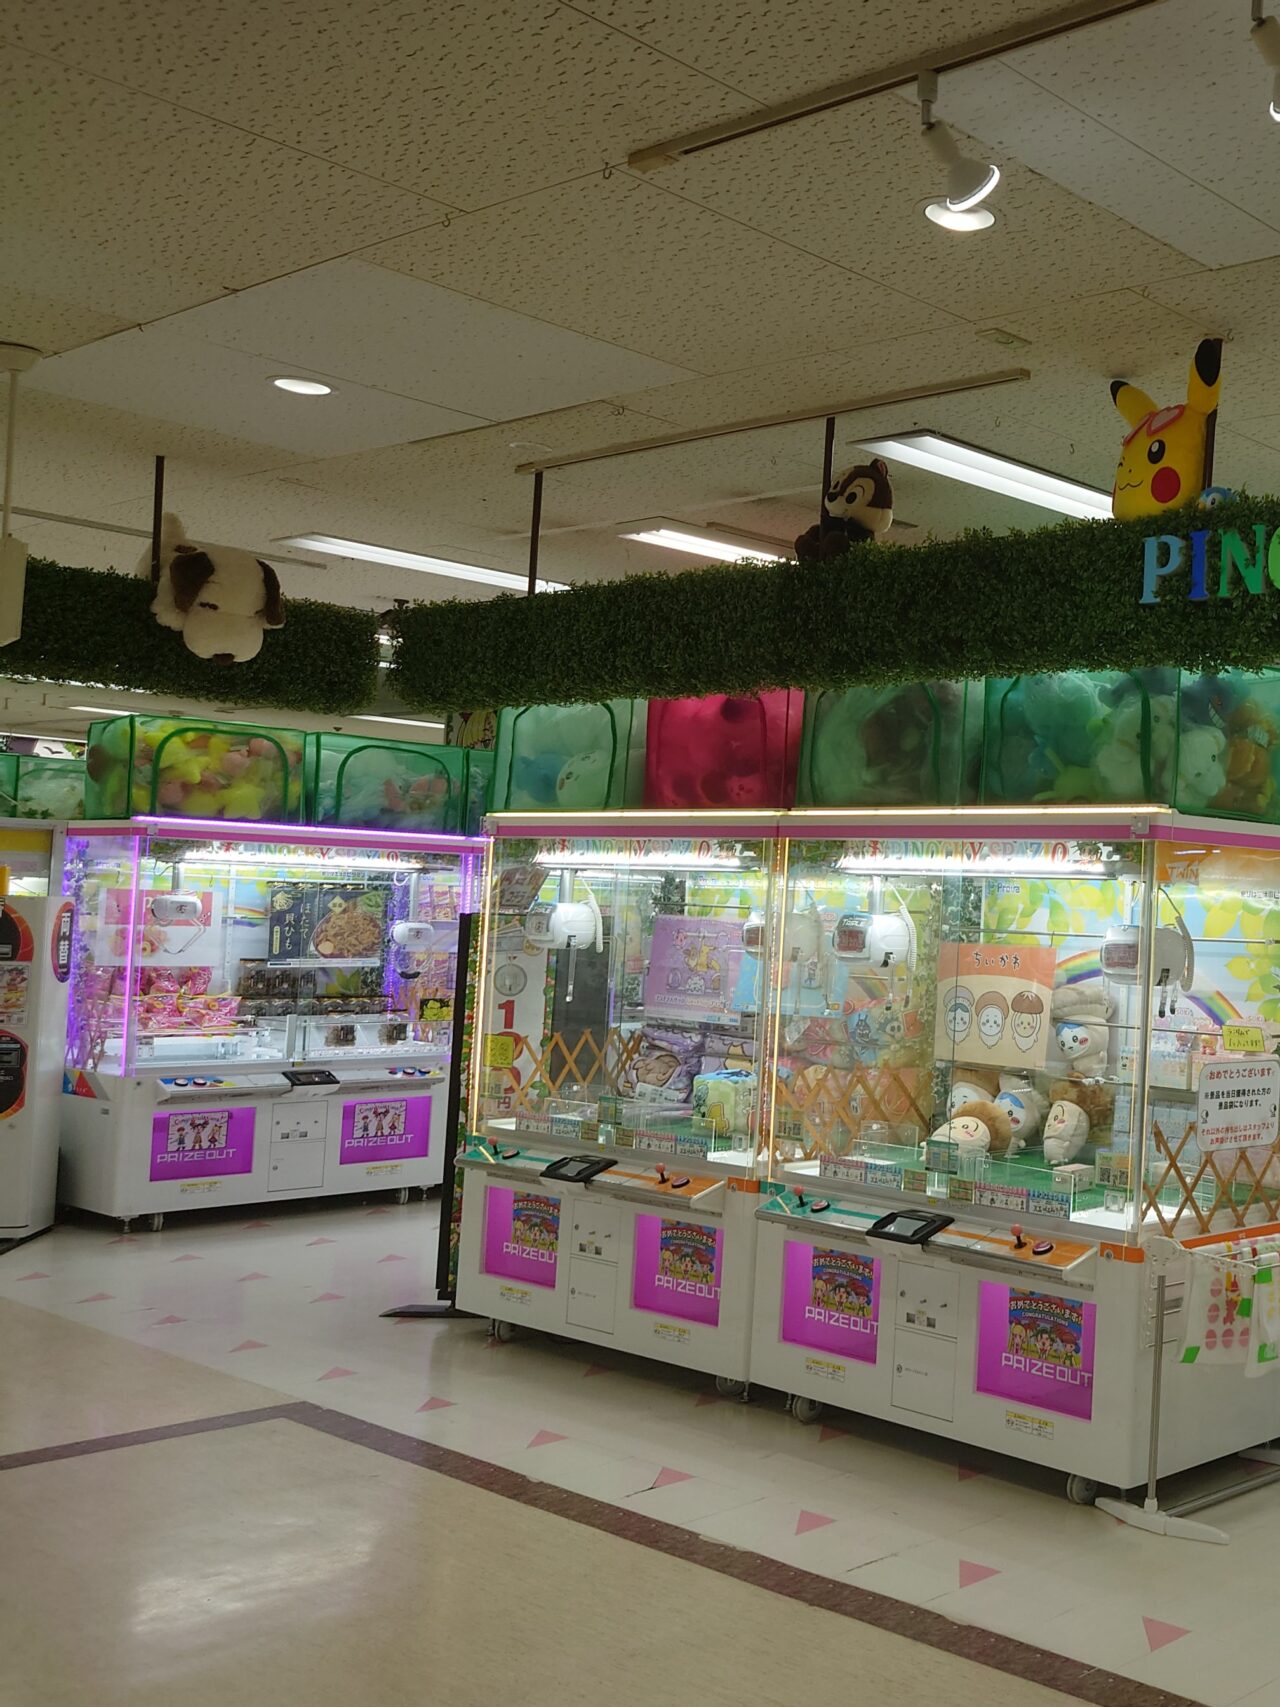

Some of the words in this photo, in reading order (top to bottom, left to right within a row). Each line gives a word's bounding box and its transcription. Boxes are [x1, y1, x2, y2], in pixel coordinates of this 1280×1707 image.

[890, 839, 984, 862] PINOCKY
[988, 839, 1070, 862] SPAZIO
[971, 950, 1023, 968] ちいかわ
[1208, 1067, 1272, 1080] おめでとうございます
[344, 1134, 415, 1149] PRIZEOUT
[156, 1148, 238, 1164] PRIZEOUT
[655, 1274, 721, 1300] PRIZEOUT
[805, 1305, 879, 1336] PRIZEOUT
[1001, 1352, 1093, 1388] PRIZEOUT
